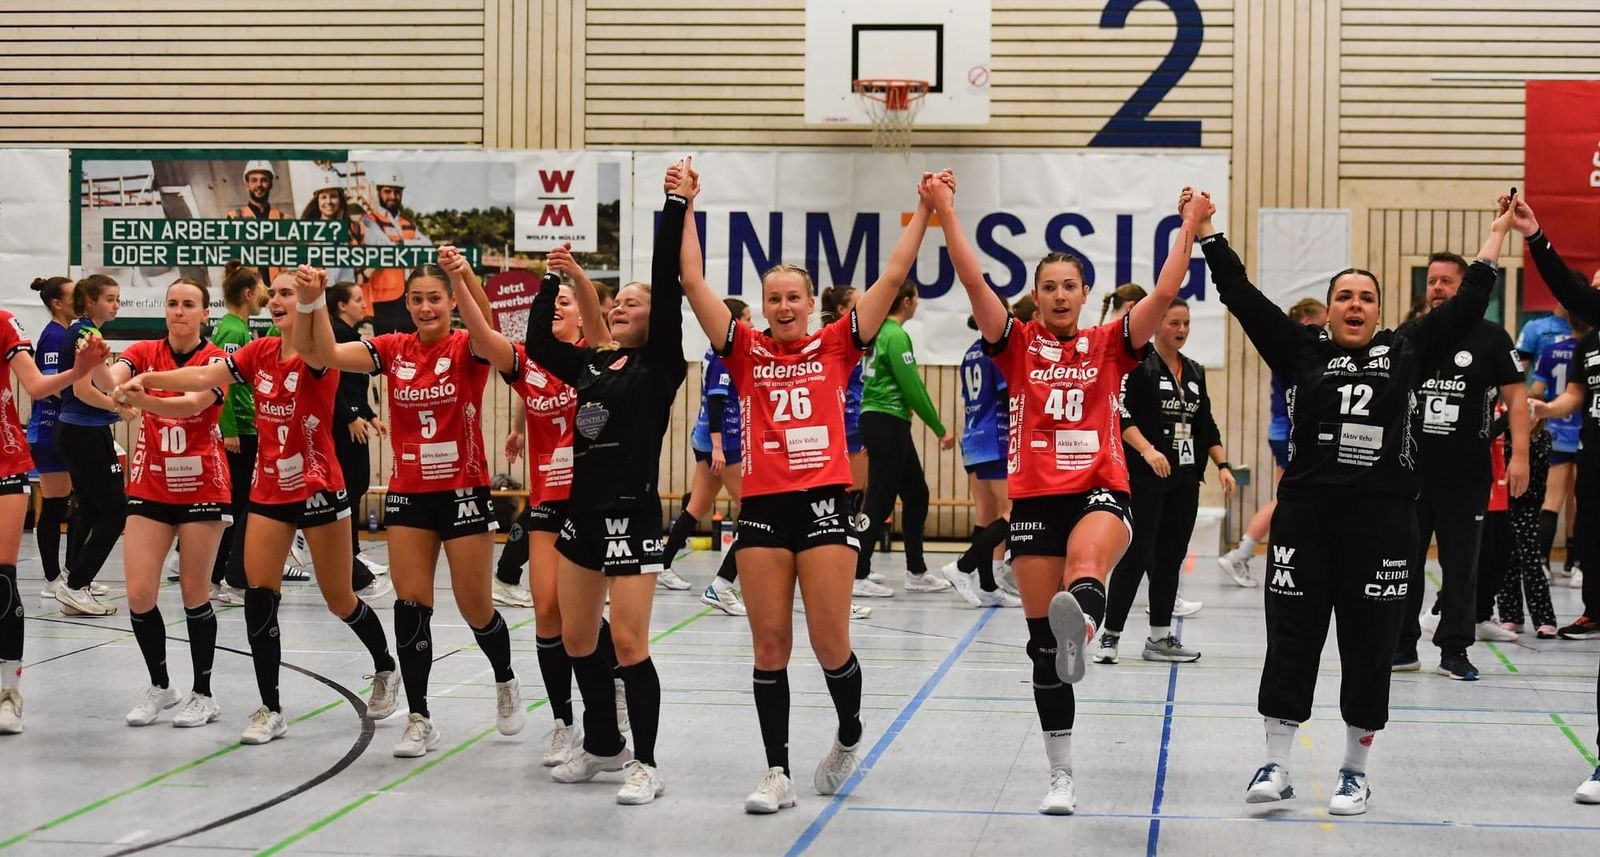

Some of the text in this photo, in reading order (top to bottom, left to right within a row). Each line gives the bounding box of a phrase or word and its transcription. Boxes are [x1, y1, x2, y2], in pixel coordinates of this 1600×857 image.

[1087, 0, 1203, 147] 2
[112, 221, 342, 241] EIN ARBEITSPLATZ?
[112, 245, 478, 267] ODER EINE NEUE PERSPEKTI!
[497, 282, 526, 296] Jetzt
[753, 353, 824, 380] adensio
[394, 376, 456, 401] adensio
[769, 387, 812, 422] 26
[1044, 388, 1084, 422] 48
[1337, 383, 1374, 416] 12
[1430, 397, 1443, 414] C
[418, 410, 437, 439] 5
[158, 426, 188, 455] 10
[1181, 440, 1192, 457] A
[810, 497, 835, 518] W
[605, 517, 630, 535] W
[1011, 534, 1033, 542] Kempa
[606, 540, 633, 558] M
[1273, 545, 1296, 565] W
[1382, 558, 1407, 568] Kempa
[1271, 569, 1296, 588] M
[1364, 583, 1408, 597] CAB
